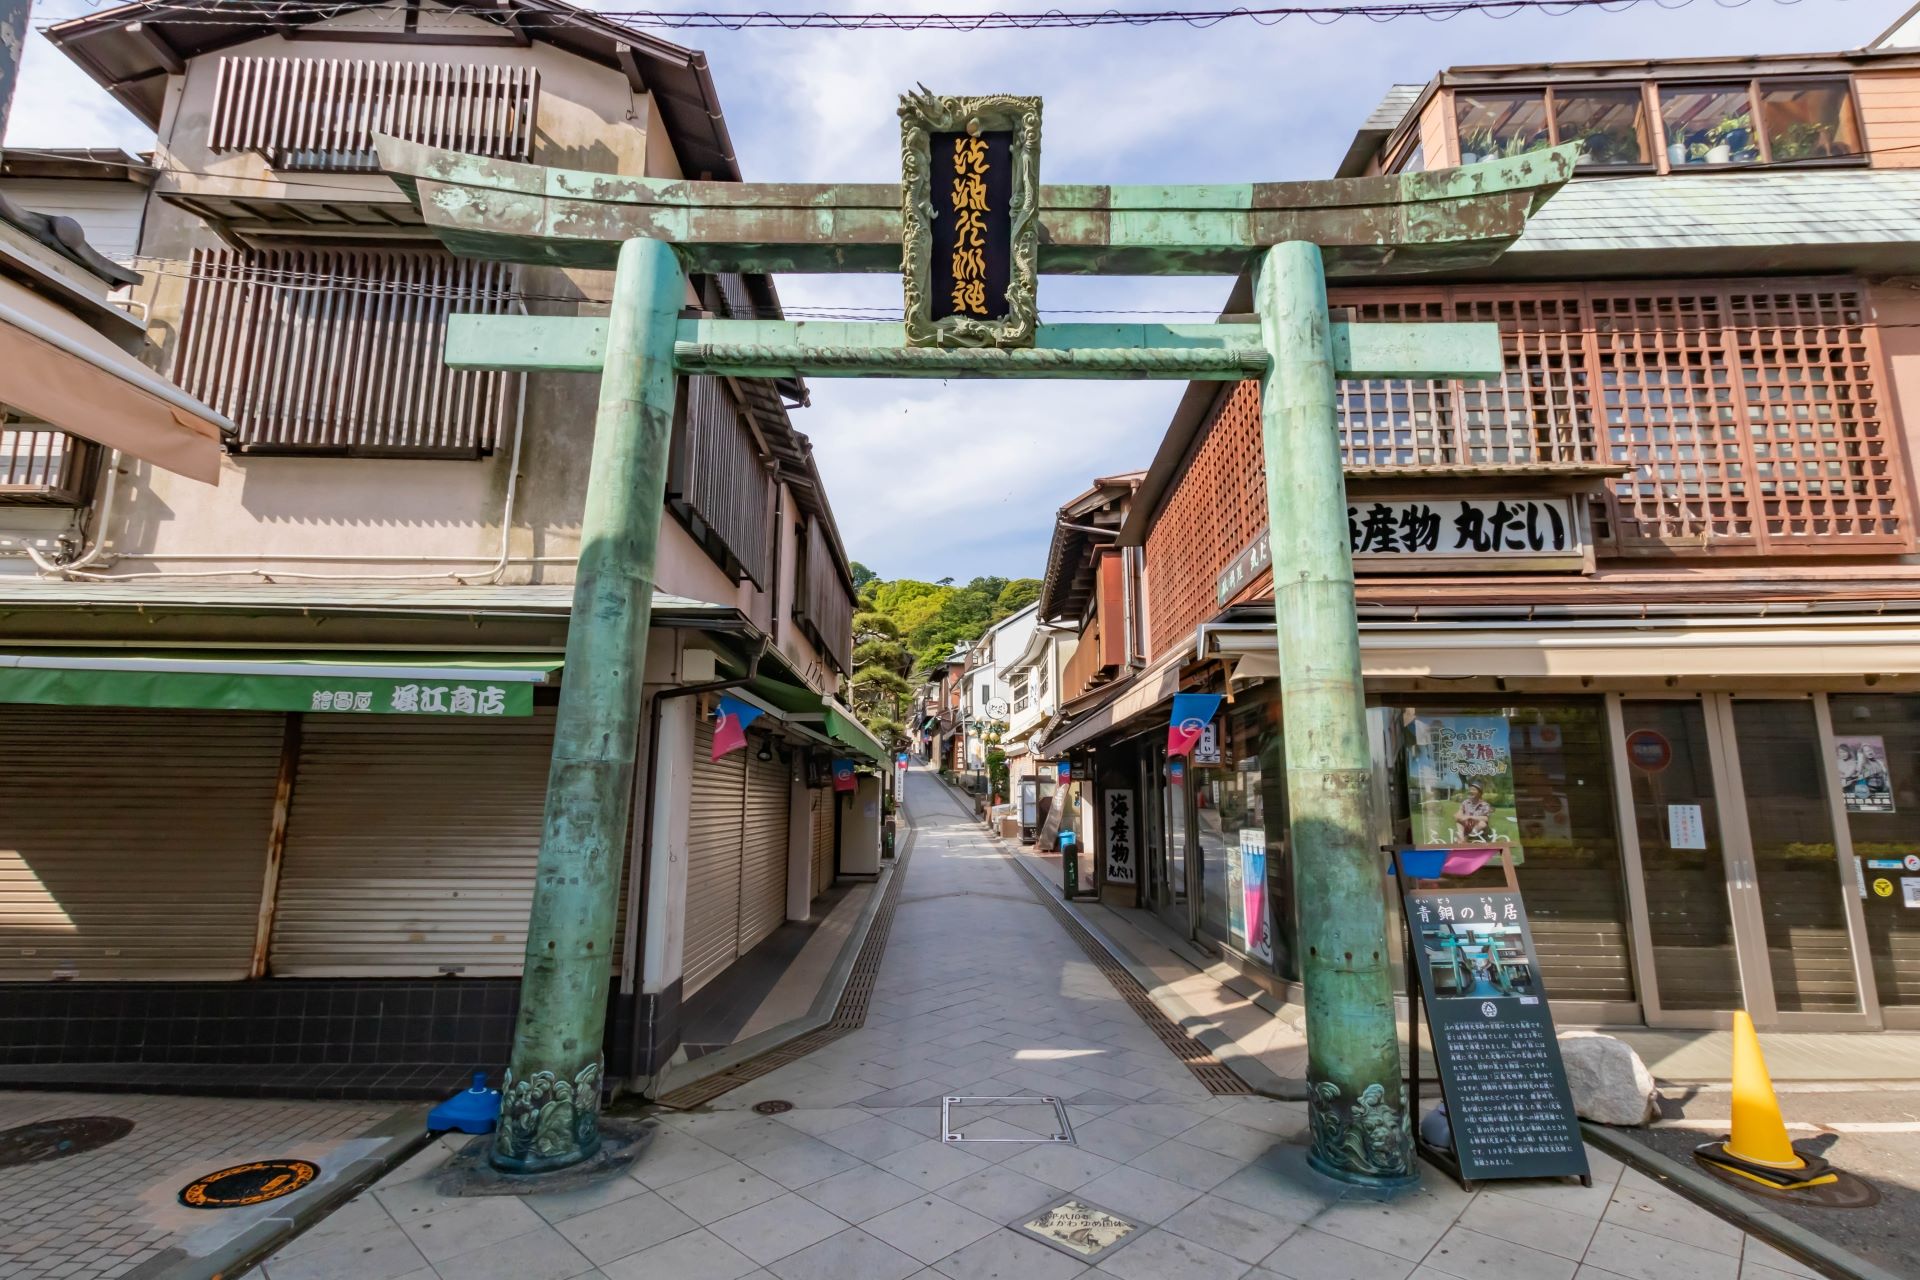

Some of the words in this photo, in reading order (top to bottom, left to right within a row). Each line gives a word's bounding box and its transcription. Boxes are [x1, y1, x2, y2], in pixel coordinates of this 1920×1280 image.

[1454, 501, 1565, 552] 丸だい
[390, 684, 506, 715] 堀江商店
[1110, 793, 1130, 864] 海産物
[1416, 903, 1518, 923] 青銅の鳥居
